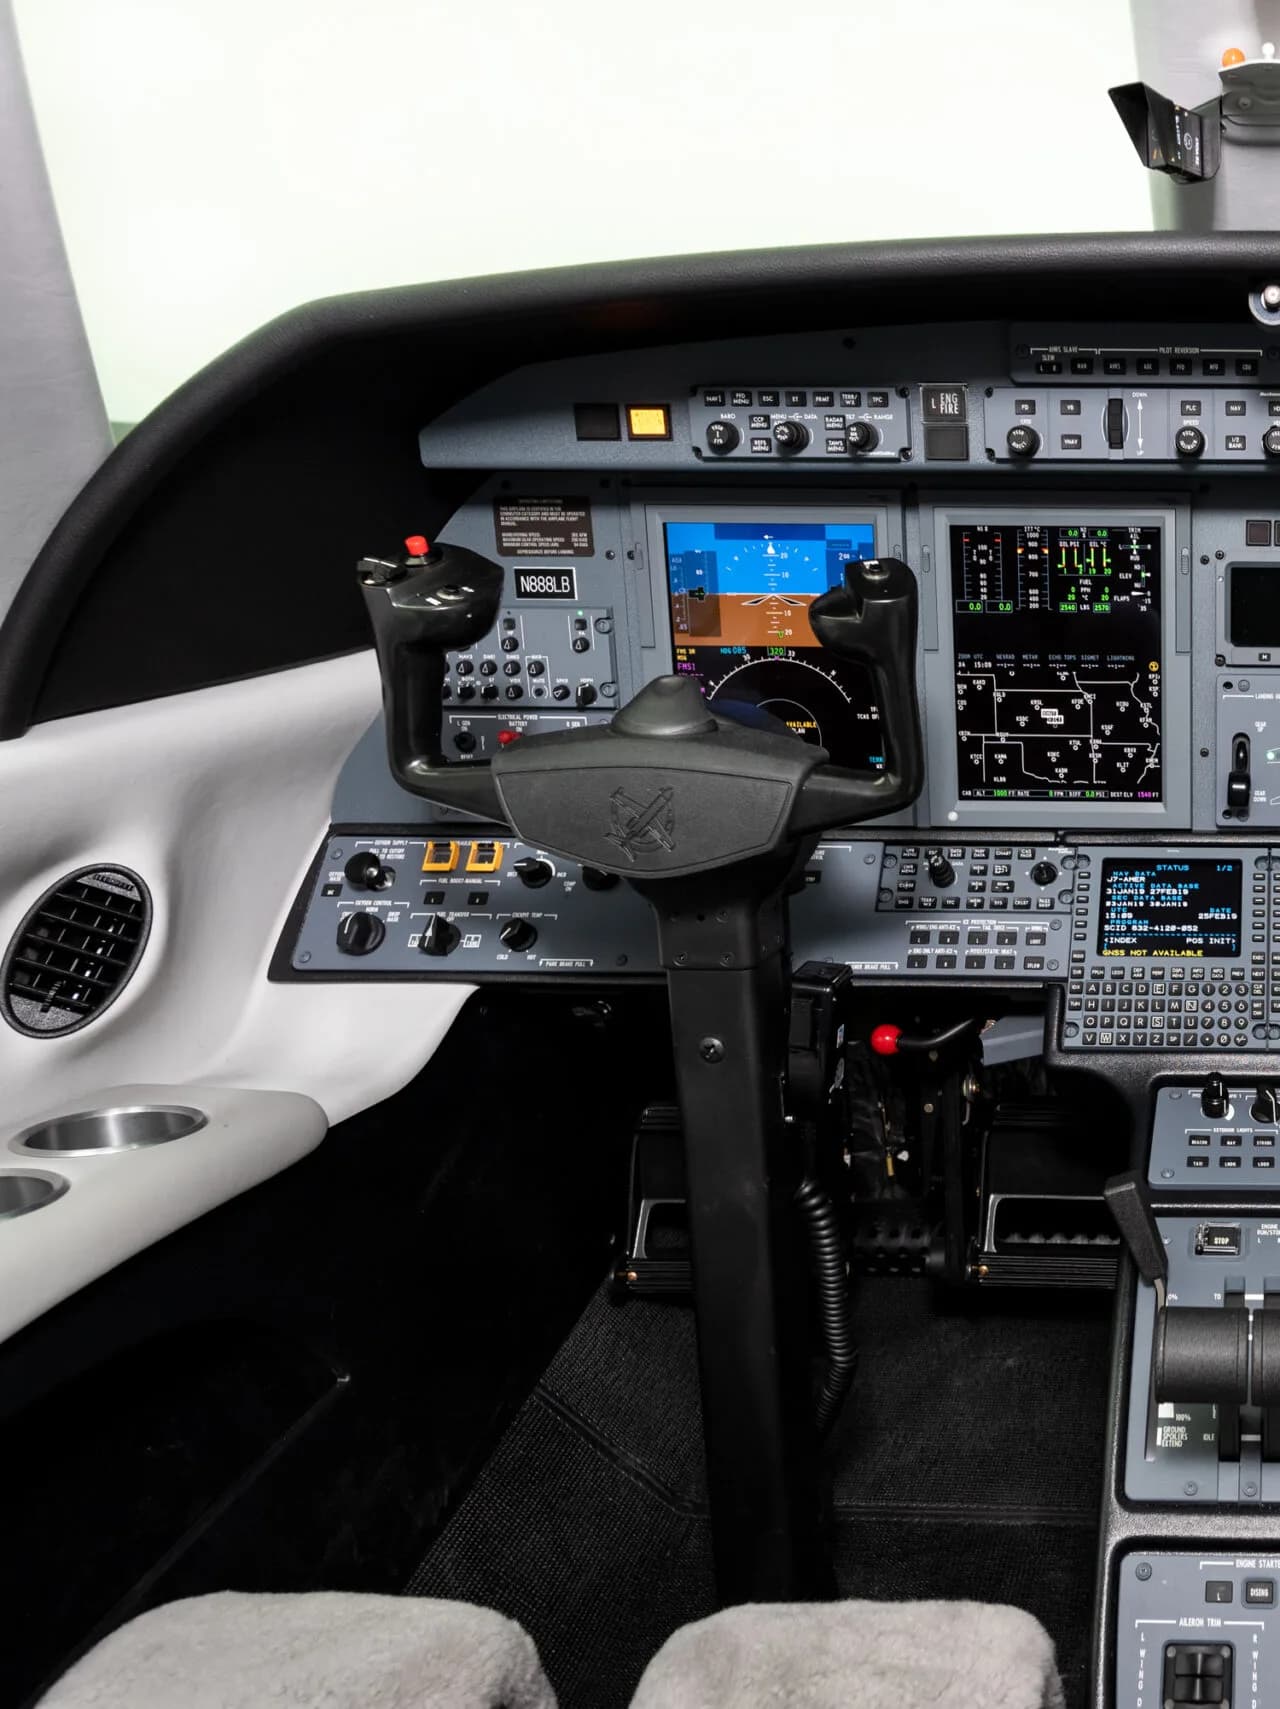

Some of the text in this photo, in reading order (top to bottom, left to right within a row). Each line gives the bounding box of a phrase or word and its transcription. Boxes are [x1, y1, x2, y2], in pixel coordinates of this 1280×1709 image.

[940, 393, 959, 404] ENG
[940, 403, 959, 415] FIRE
[520, 576, 570, 592] N888LB
[1236, 1560, 1255, 1568] ENGINE
[1217, 1593, 1220, 1601] L
[1250, 1588, 1268, 1597] DISENG
[1179, 1618, 1221, 1627] AILERON TRIM
